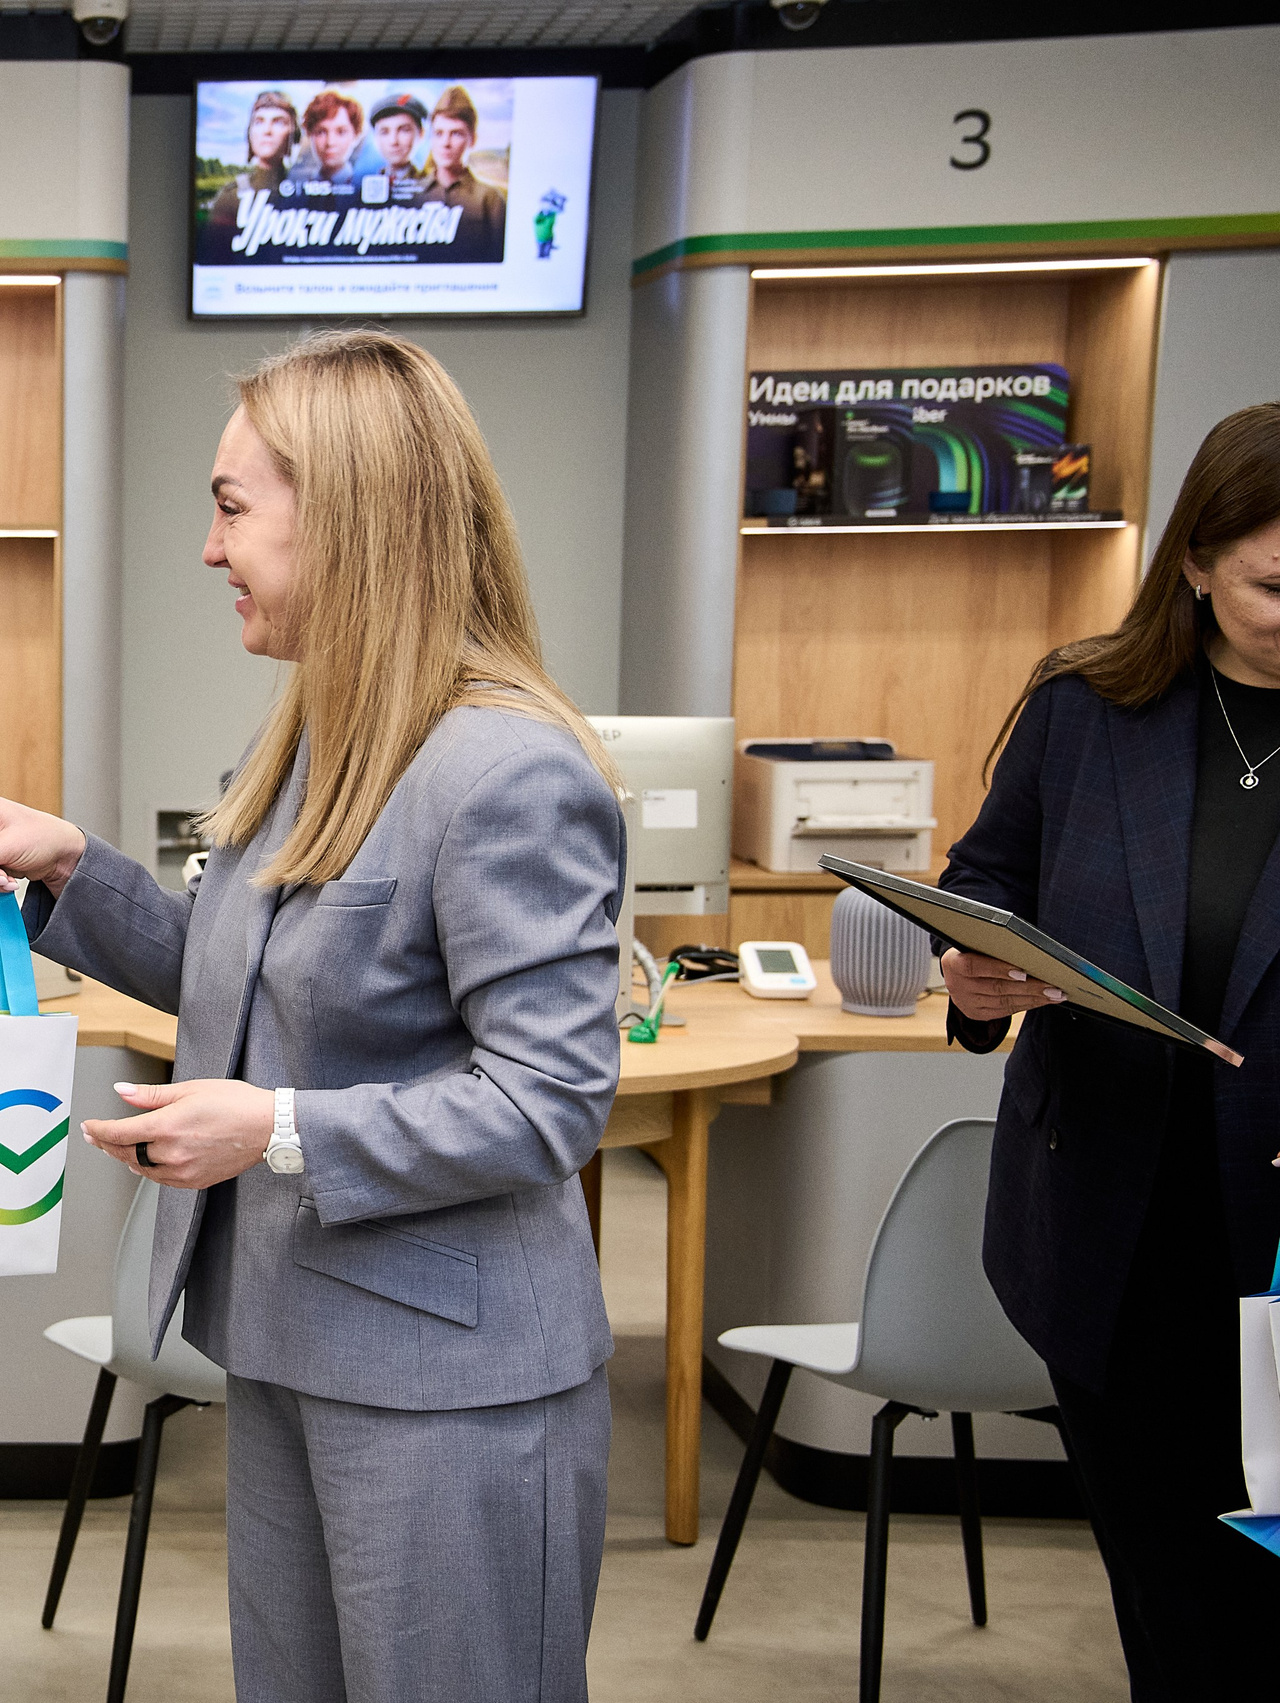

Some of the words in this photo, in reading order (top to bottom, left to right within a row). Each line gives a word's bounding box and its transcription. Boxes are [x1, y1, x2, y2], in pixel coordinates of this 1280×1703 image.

[949, 108, 991, 171] 3
[231, 187, 340, 257] Уроки
[333, 201, 464, 255] мужества
[749, 375, 830, 406] Идеи
[834, 379, 894, 405] для
[901, 375, 1051, 403] подарков
